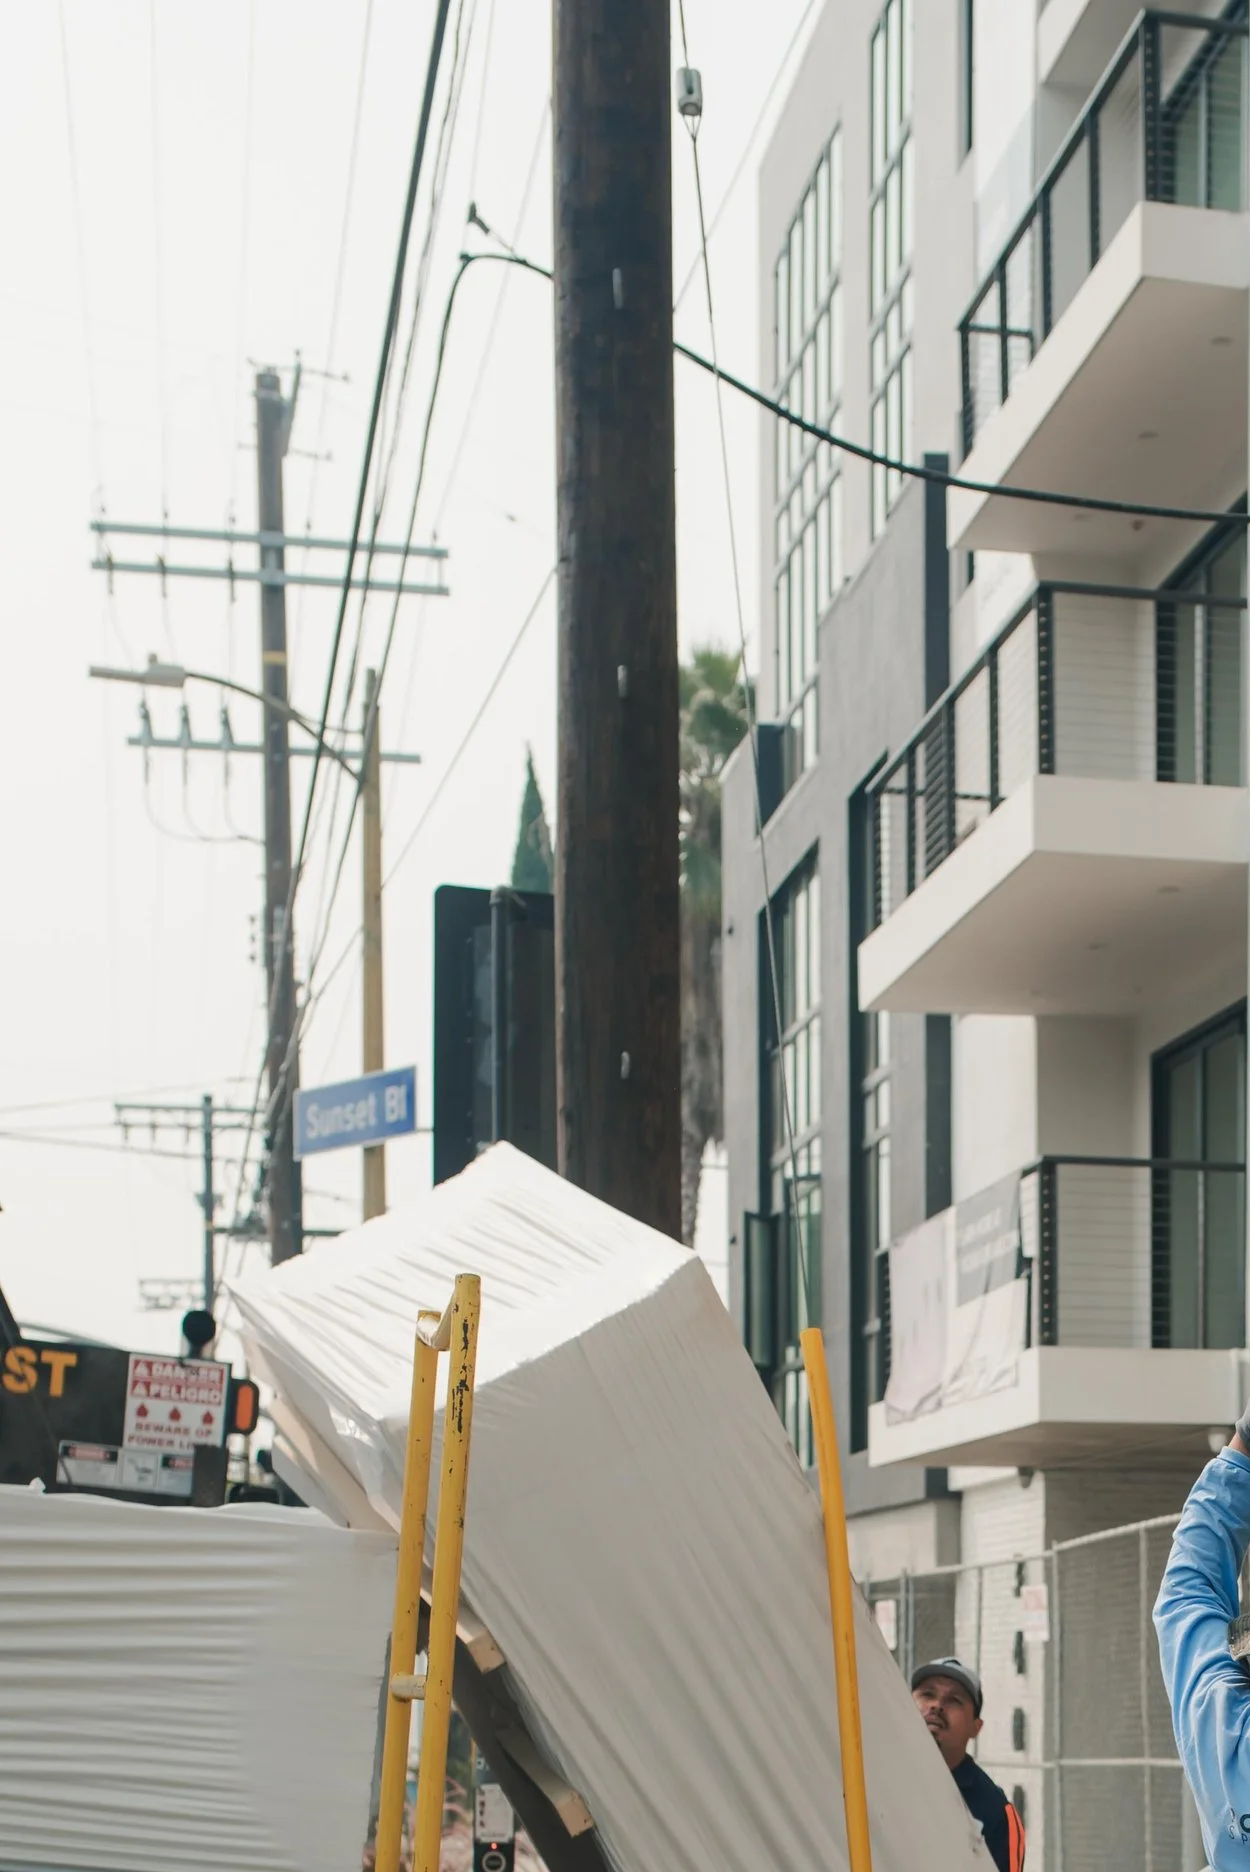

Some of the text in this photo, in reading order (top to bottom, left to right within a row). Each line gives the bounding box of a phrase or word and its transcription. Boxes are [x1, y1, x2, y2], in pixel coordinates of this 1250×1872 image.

[306, 1084, 407, 1138] Sunset Bl
[2, 1346, 77, 1397] ST
[149, 1382, 221, 1404] PELIGRO
[135, 1421, 190, 1437] BEWARE
[127, 1433, 175, 1448] POWER
